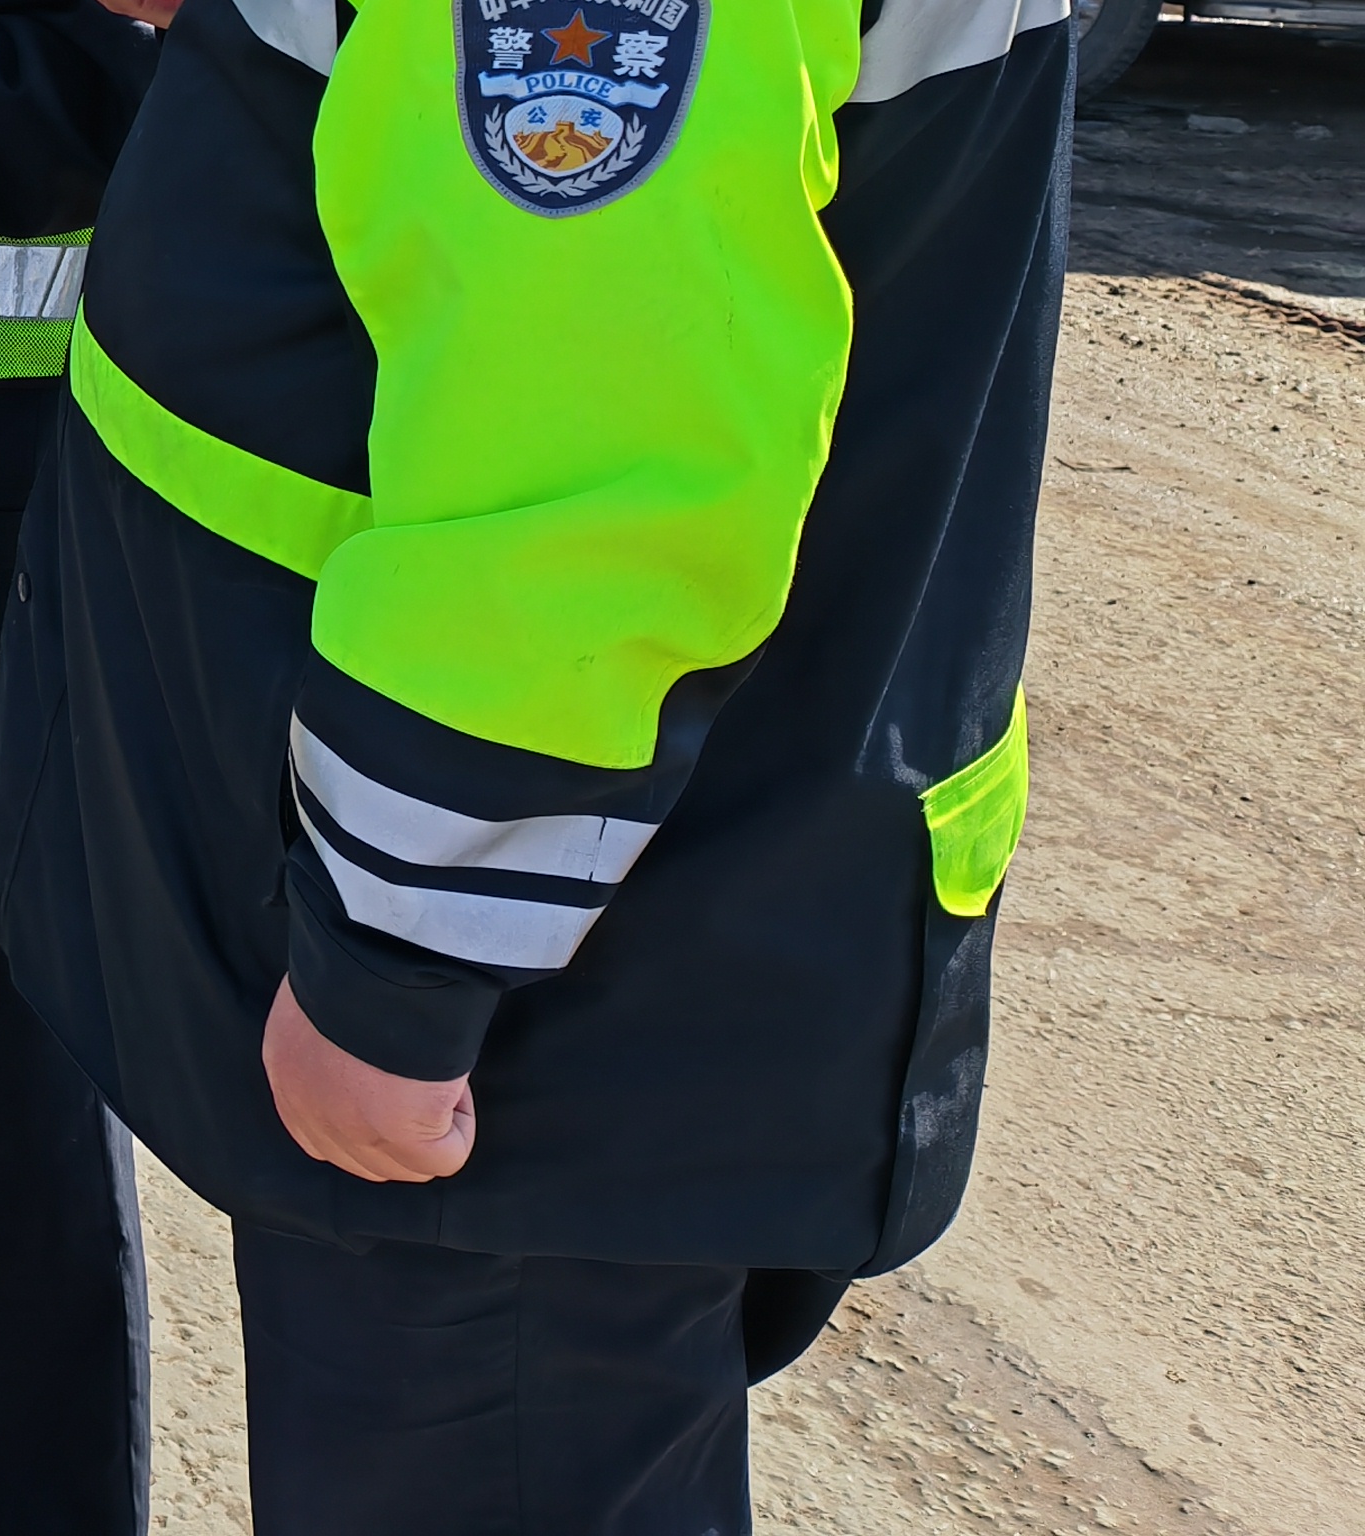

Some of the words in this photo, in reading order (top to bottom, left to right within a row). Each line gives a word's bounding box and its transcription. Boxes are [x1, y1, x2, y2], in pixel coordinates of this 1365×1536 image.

[488, 26, 669, 79] 警察
[525, 73, 615, 99] POLICE
[527, 105, 602, 128] 公安
